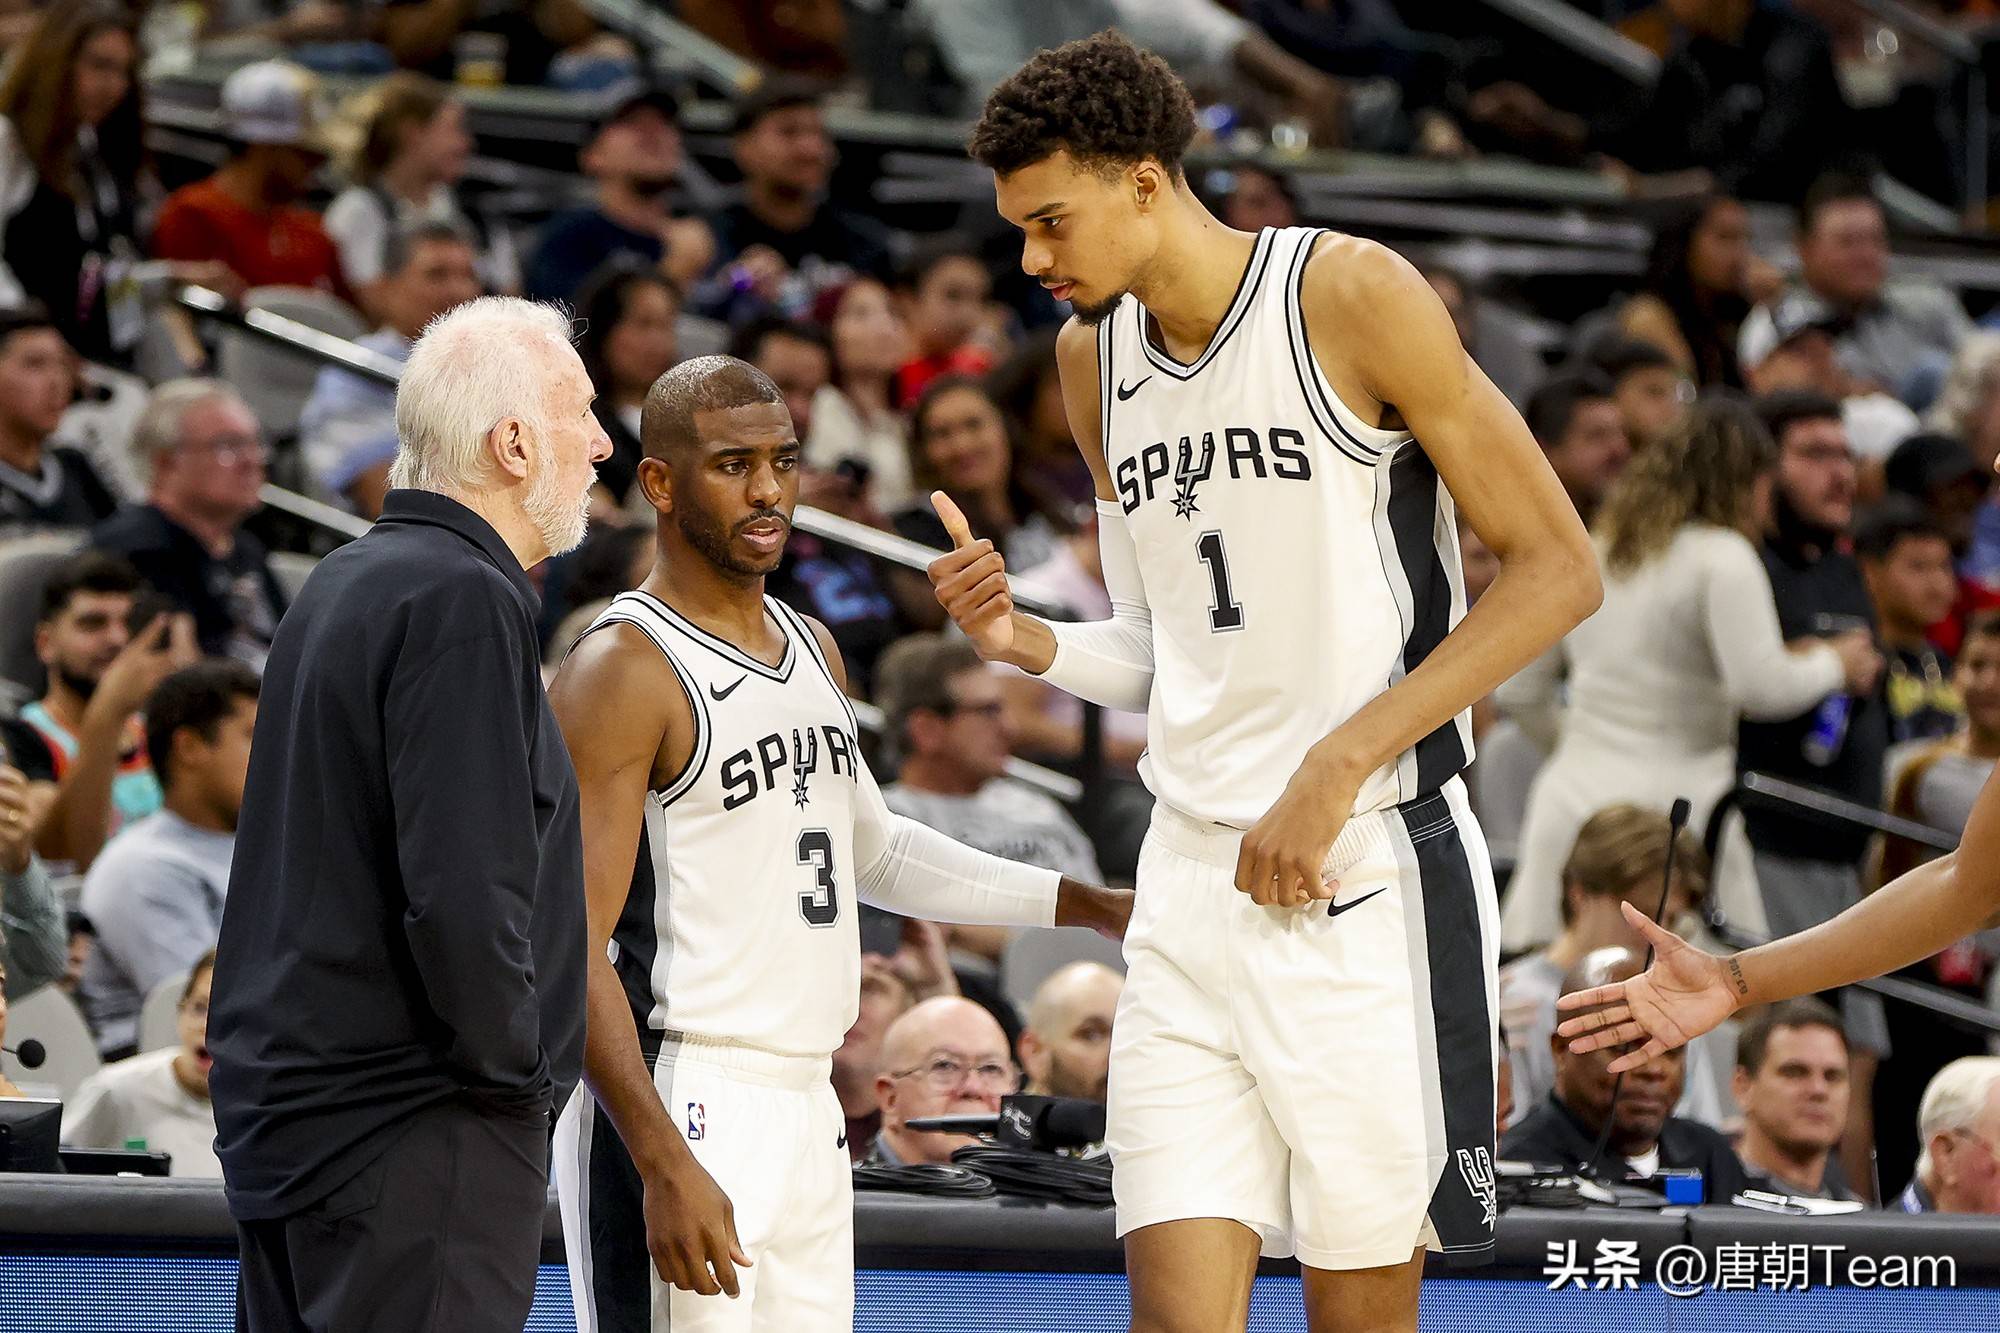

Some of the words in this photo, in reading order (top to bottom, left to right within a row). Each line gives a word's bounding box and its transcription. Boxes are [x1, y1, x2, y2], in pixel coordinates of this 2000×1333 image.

[1117, 427, 1312, 520] SPURS
[1195, 529, 1245, 633] 1
[795, 828, 840, 928] 3
